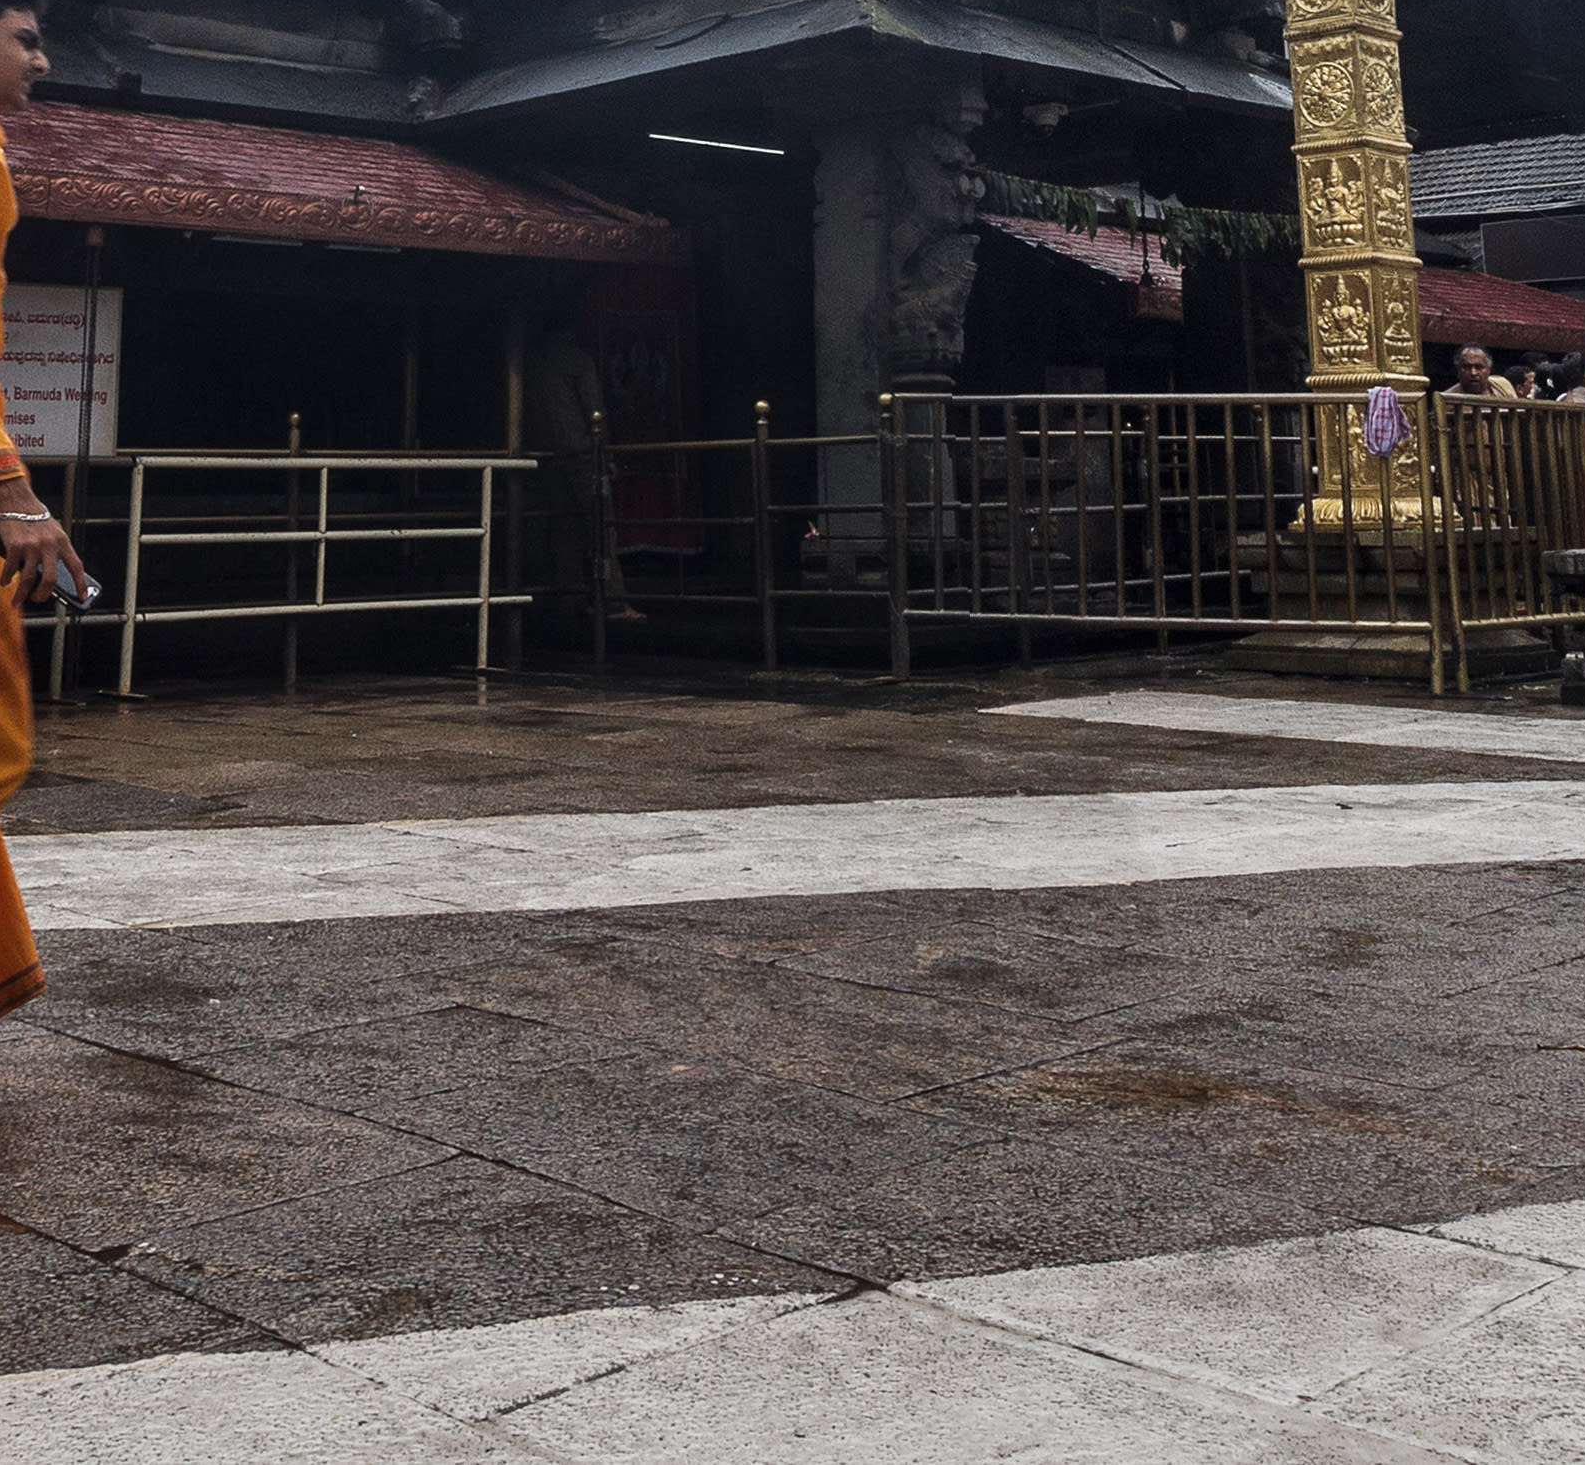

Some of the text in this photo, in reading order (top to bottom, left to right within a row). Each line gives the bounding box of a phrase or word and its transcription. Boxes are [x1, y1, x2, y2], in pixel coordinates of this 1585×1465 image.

[14, 386, 62, 401] Barmuda
[4, 412, 36, 425] mises
[10, 434, 45, 448] ibited
